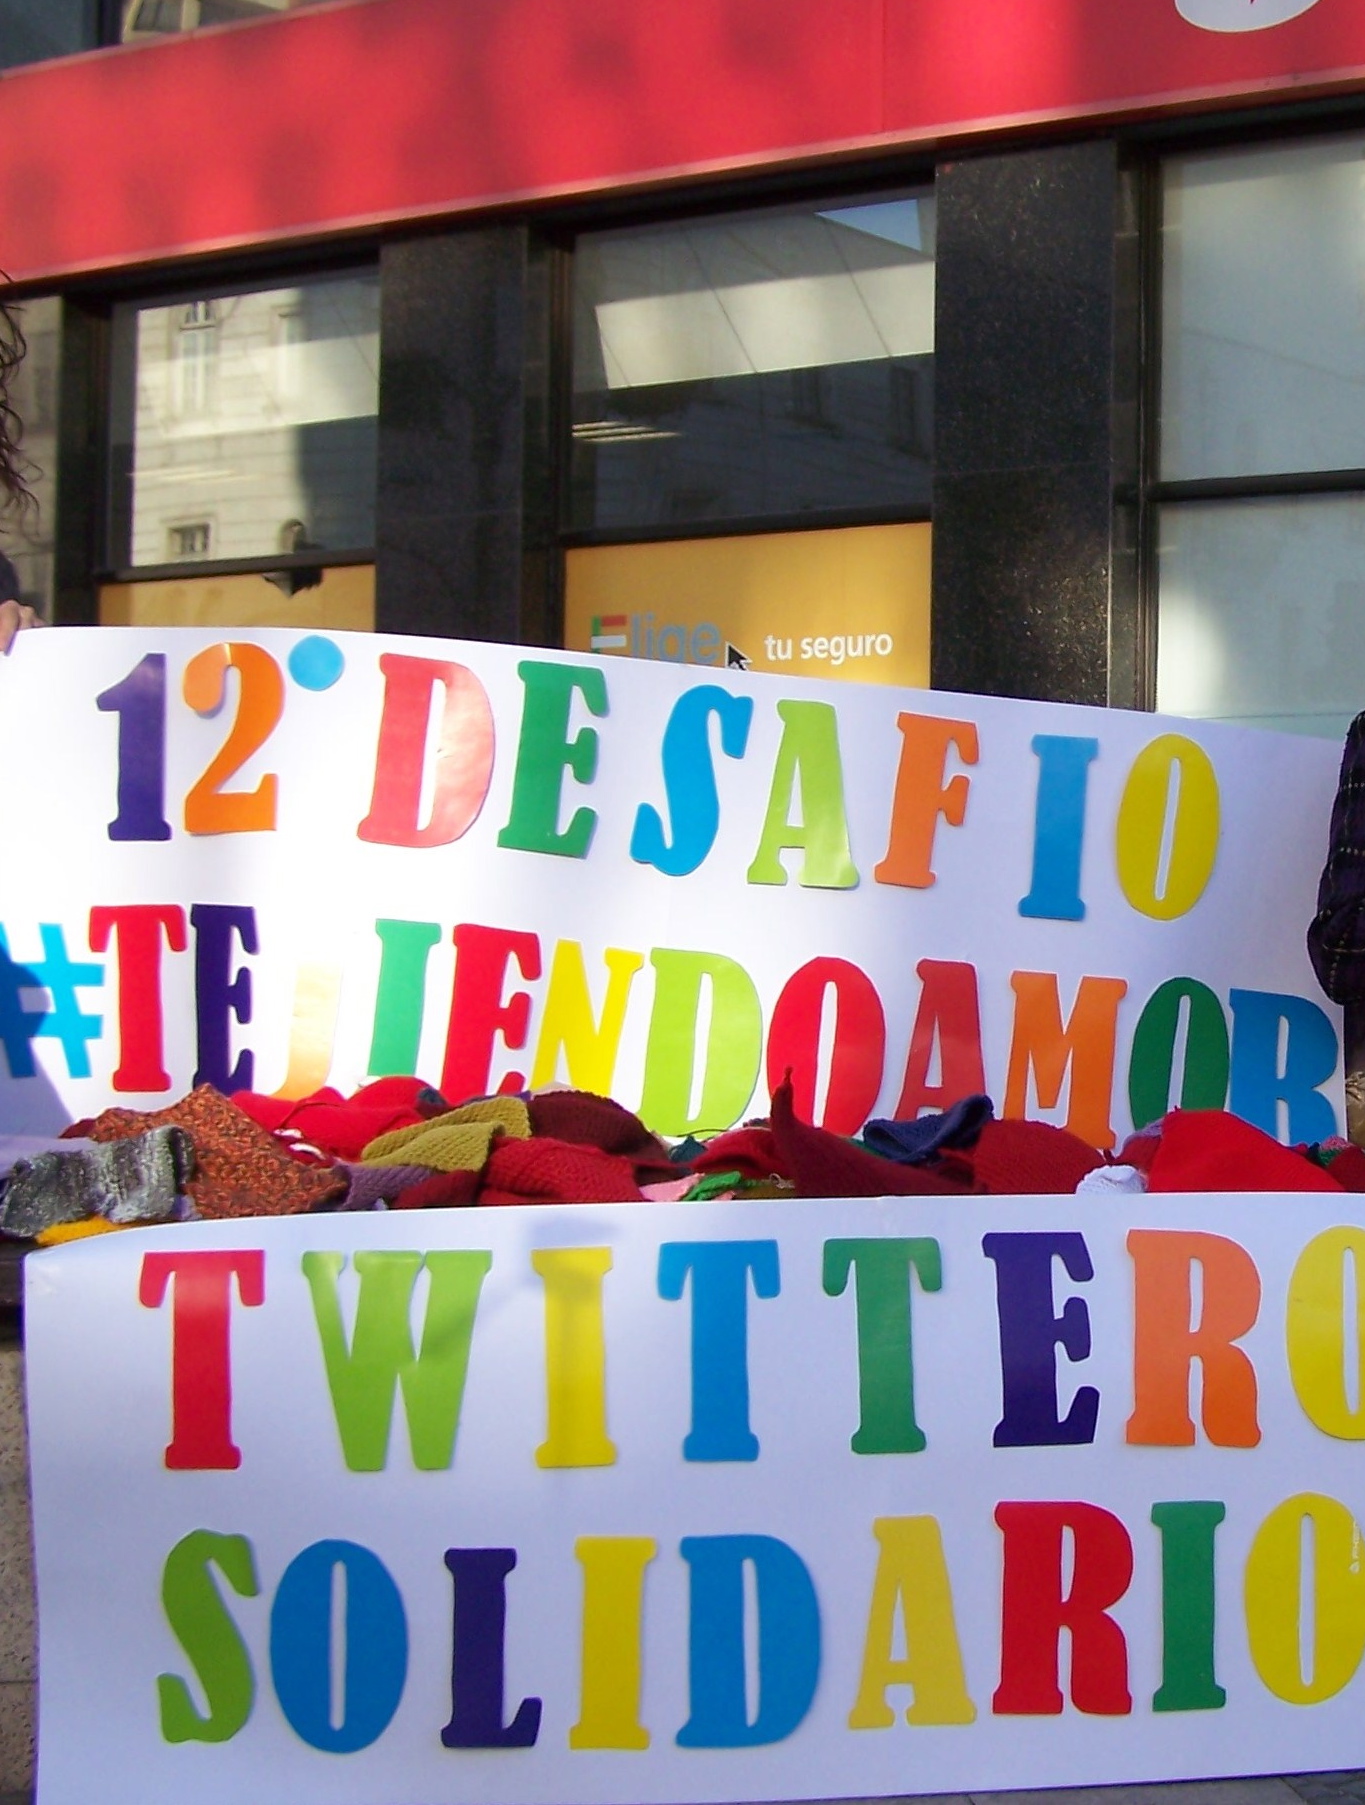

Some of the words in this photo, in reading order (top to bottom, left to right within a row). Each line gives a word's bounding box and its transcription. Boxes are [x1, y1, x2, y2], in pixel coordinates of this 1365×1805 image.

[764, 634, 793, 661] tu
[800, 633, 893, 665] seguro
[357, 652, 1220, 922] DESAFIO
